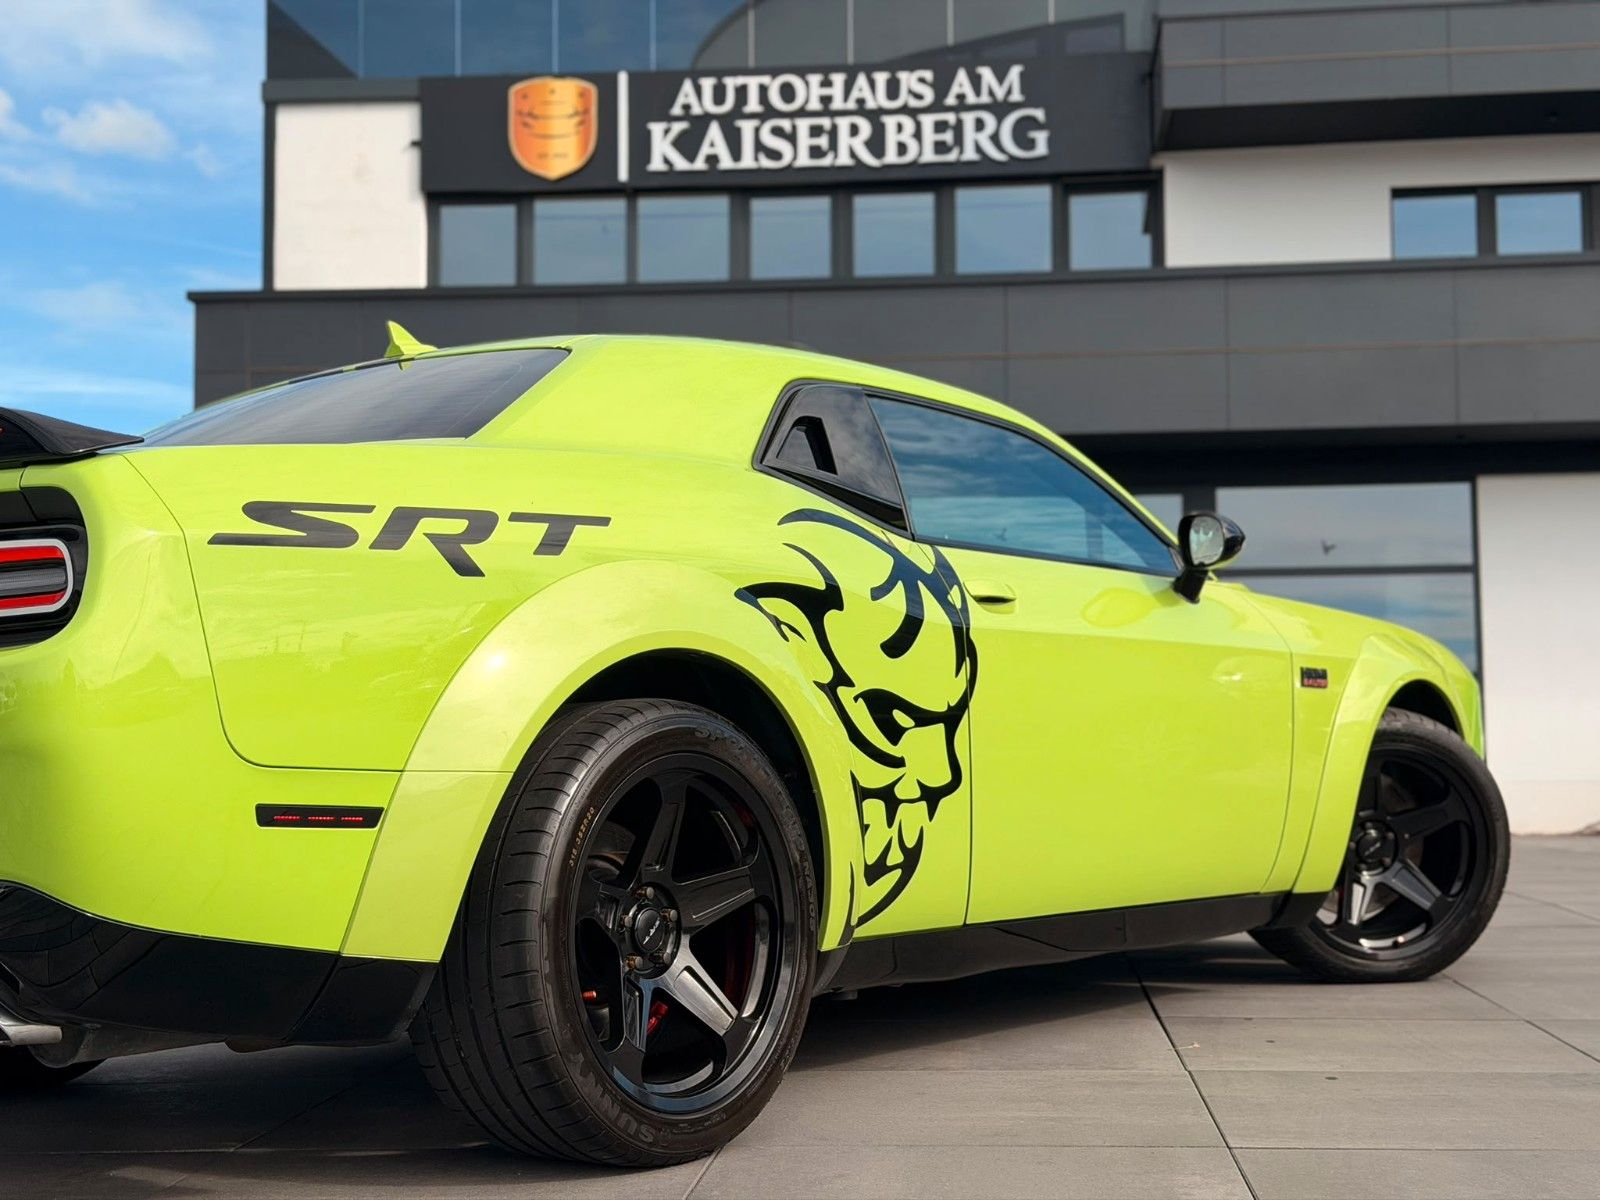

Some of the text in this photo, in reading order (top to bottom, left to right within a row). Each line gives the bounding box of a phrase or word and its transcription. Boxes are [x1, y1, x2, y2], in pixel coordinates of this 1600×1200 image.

[670, 65, 1023, 116] AUTOHAUS AM
[647, 108, 1050, 171] KAISERBERG
[207, 501, 611, 577] SRT
